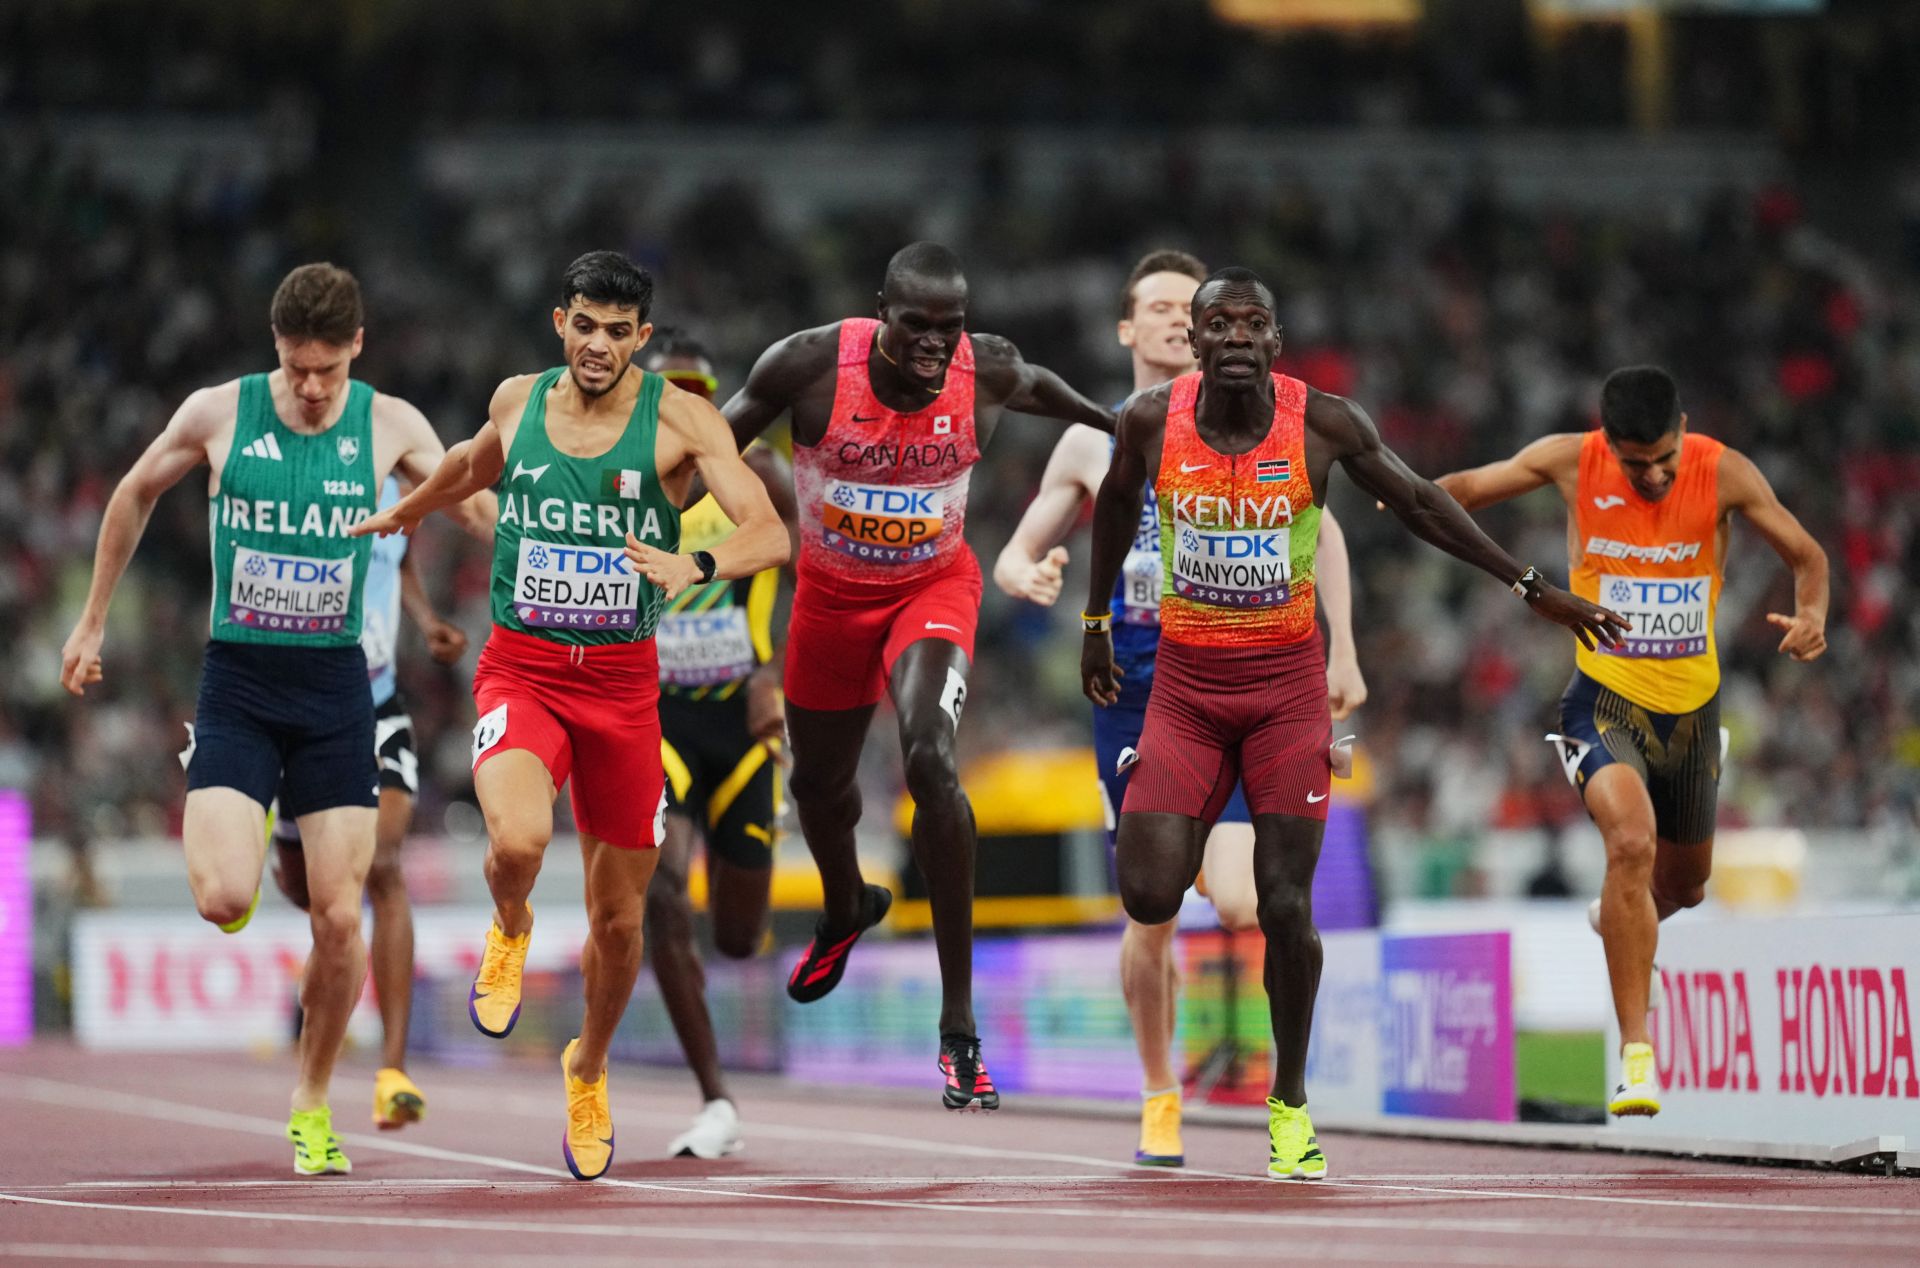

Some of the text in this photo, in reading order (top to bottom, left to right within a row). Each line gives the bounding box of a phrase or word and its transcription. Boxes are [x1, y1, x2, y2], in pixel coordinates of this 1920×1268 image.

[839, 442, 958, 467] CANADA
[323, 480, 365, 496] 123.ie
[858, 488, 935, 514] TDK
[500, 493, 662, 540] ALGERIA
[1172, 491, 1293, 528] KENYA
[837, 514, 927, 544] AROP
[1199, 534, 1281, 559] TDK
[1586, 536, 1702, 564] ESPAÑA
[268, 557, 343, 584] TDK
[550, 548, 630, 575] TDK
[1178, 551, 1285, 587] WANYONYI
[236, 581, 344, 615] McPHILLIPS
[522, 576, 631, 606] SEDJATI
[1632, 581, 1703, 604] TDK
[1613, 611, 1703, 636] TTAOUI
[1650, 968, 1759, 1092] ONDA
[1777, 963, 1919, 1098] HONDA
